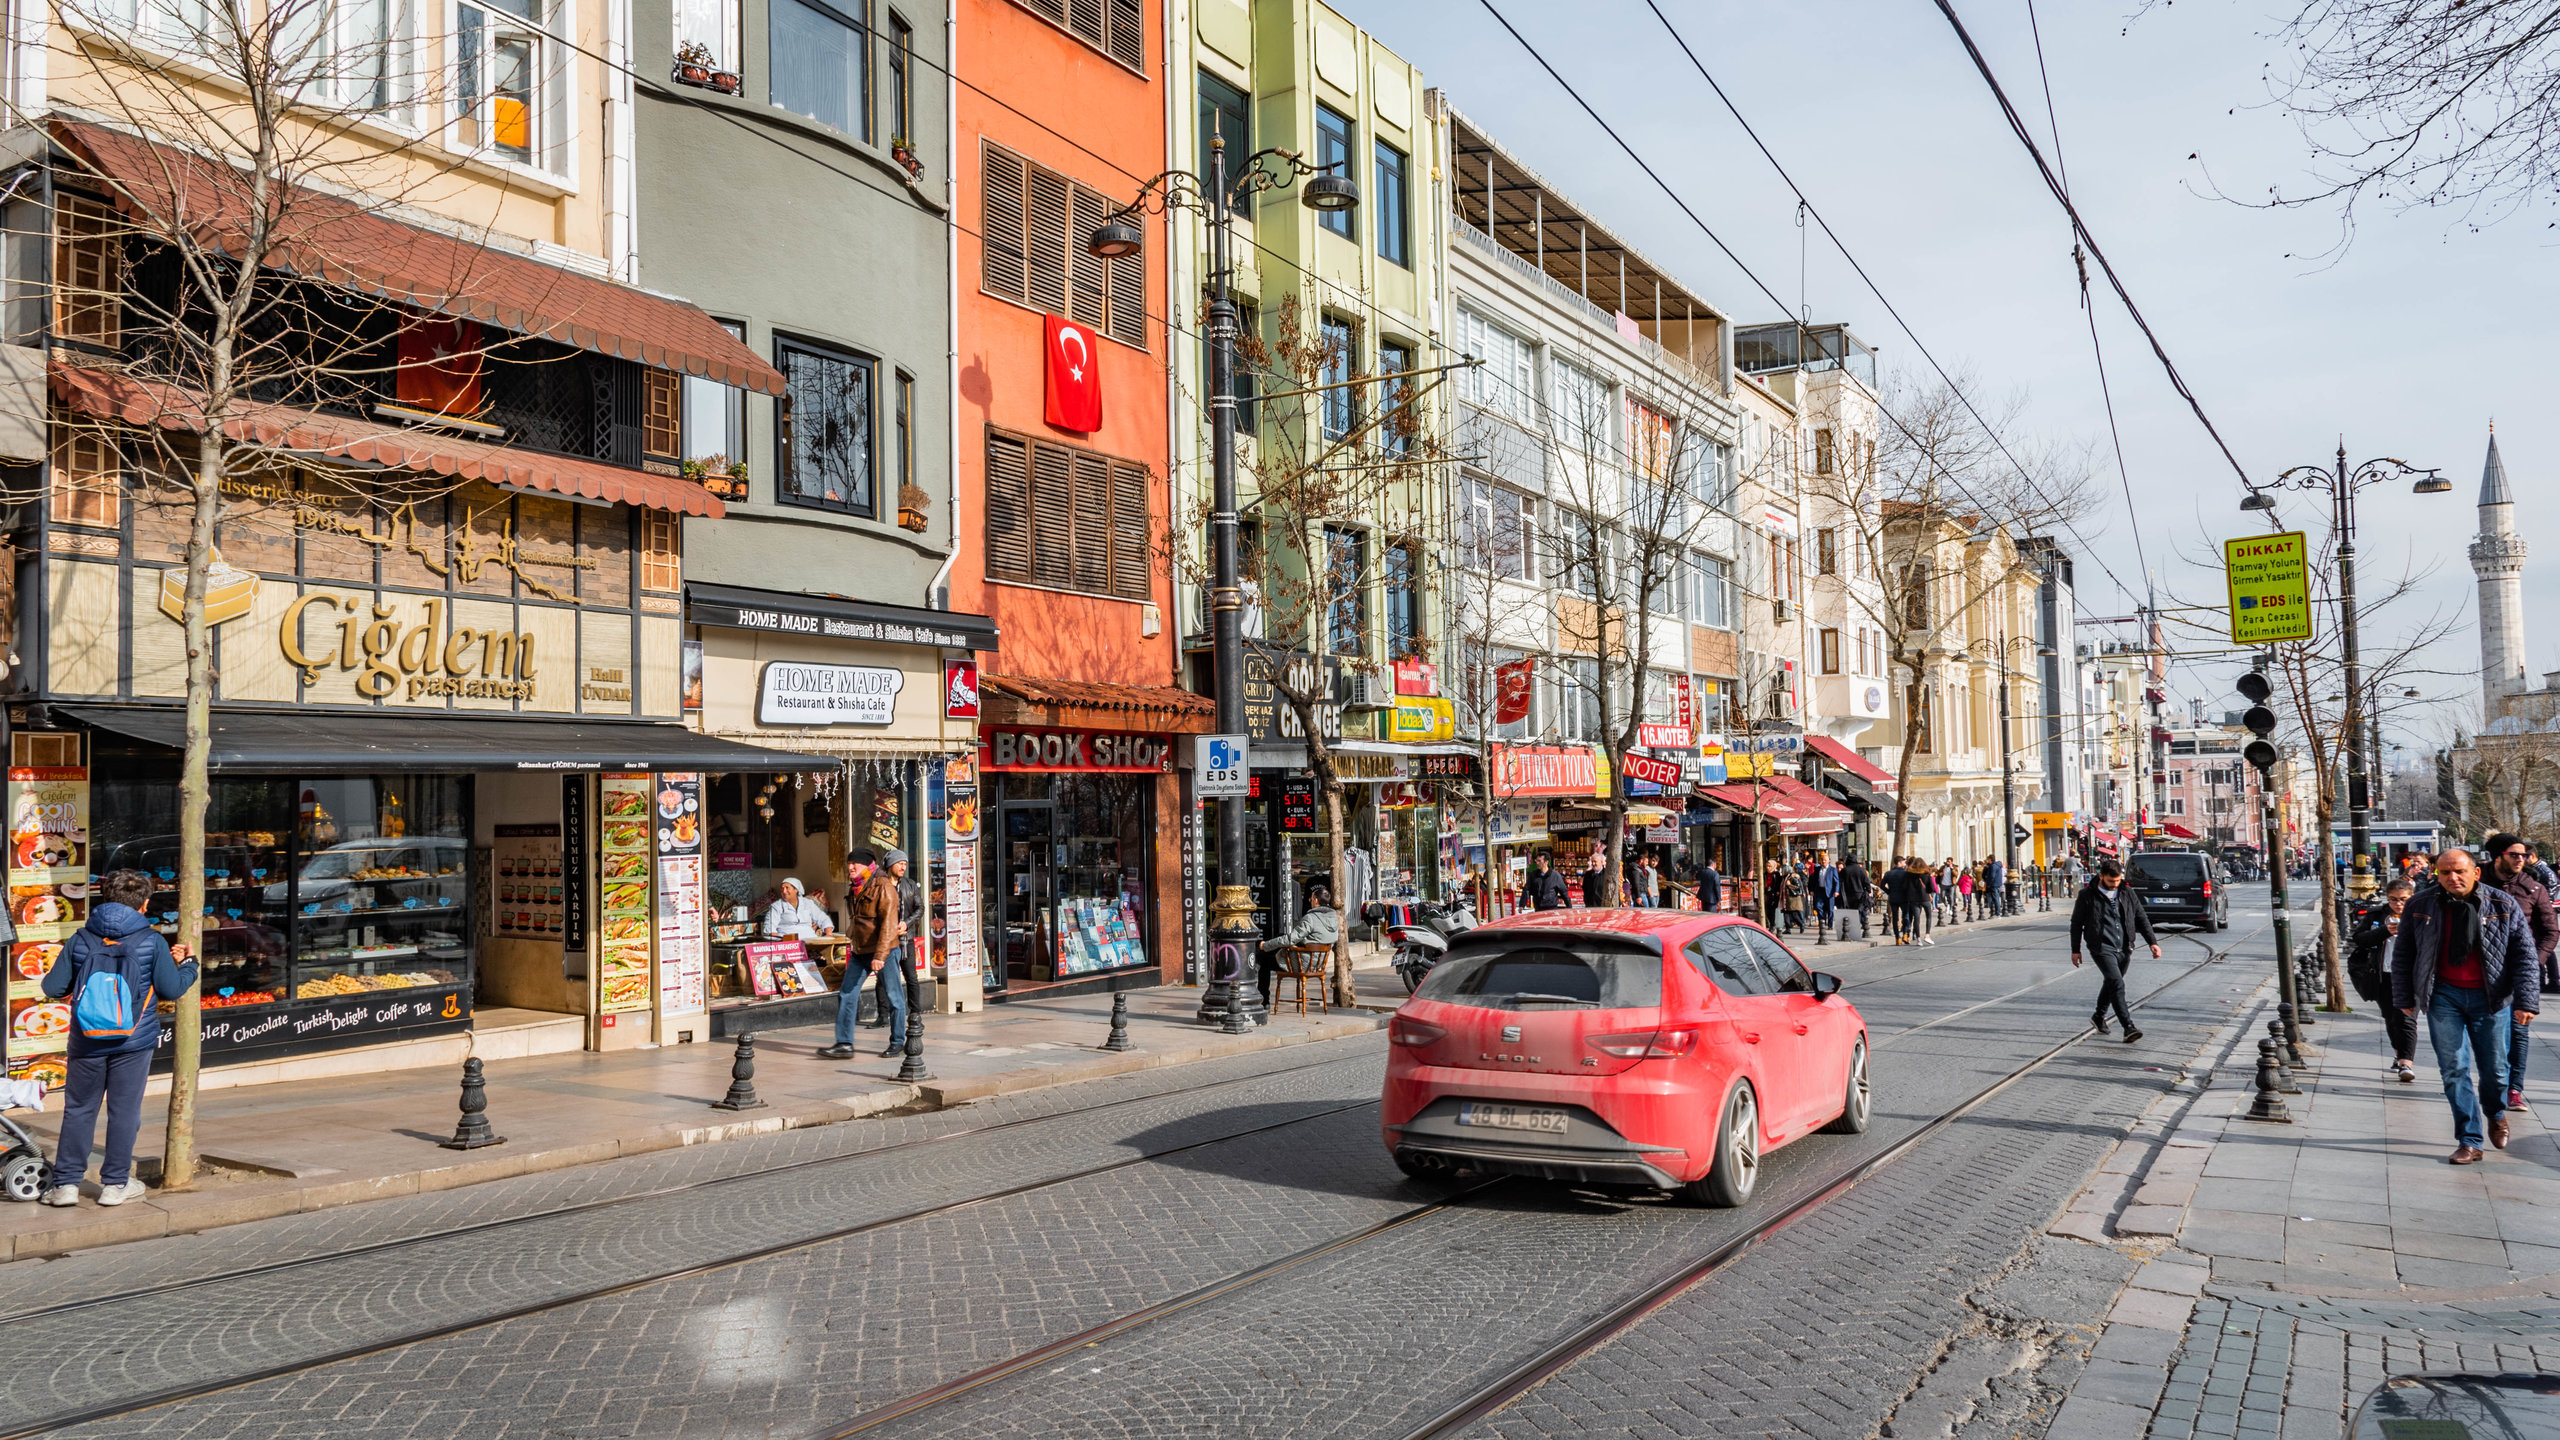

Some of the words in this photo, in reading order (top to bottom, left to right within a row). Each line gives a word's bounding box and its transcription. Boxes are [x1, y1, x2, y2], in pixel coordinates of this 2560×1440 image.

[2237, 542, 2293, 557] DİKKAT
[2231, 560, 2268, 573] Tramvay
[2270, 558, 2300, 569] Yoluna
[2233, 574, 2264, 585] Girmek
[2265, 571, 2302, 583] Yasaktır
[2261, 595, 2286, 608] EDS
[2288, 594, 2304, 606] ile
[738, 610, 778, 628] HOME
[780, 614, 818, 632] MADE
[824, 618, 874, 638] Restaurant
[876, 624, 884, 638] &
[885, 625, 914, 642] Shisha
[915, 627, 934, 643] Cafe
[2243, 615, 2264, 625] Para
[2268, 612, 2299, 623] Cezası
[2238, 624, 2306, 638] Kesilmektedir
[279, 592, 538, 696] Çiğdem
[407, 675, 538, 701] pastanesi
[773, 667, 834, 693] HOME
[837, 671, 893, 695] MADE
[1245, 682, 1272, 697] GROUP
[1678, 676, 1689, 686] 16.
[777, 695, 825, 710] Restaurant
[827, 697, 835, 709] &
[867, 698, 886, 711] Cafe
[1679, 688, 1690, 728] NOT
[861, 713, 874, 721] SINCE
[1280, 702, 1341, 738] CHNGE
[1642, 725, 1691, 747] 16.NOTER
[995, 731, 1086, 766] BOOK
[1094, 734, 1168, 767] SHOP
[1206, 770, 1239, 782] EDS
[1520, 753, 1563, 788] TURKEY
[1564, 754, 1597, 786] TOURS
[1622, 755, 1677, 785] NOTER
[18, 802, 77, 821] GOOD
[17, 819, 79, 834] MORNING
[1182, 814, 1193, 890] CHANGE
[1195, 814, 1204, 890] CHANGE
[1184, 897, 1195, 974] OFFICE
[1197, 897, 1206, 974] OFFICE
[293, 1008, 333, 1035] Turkish
[331, 1007, 369, 1031] Delight
[376, 1002, 408, 1024] Coffee
[413, 1002, 432, 1017] Tea
[232, 1012, 289, 1044] Chocolate
[1480, 1053, 1541, 1063] LEON
[1471, 1104, 1492, 1124] 48
[1499, 1106, 1520, 1126] BL
[1529, 1109, 1563, 1131] 662
